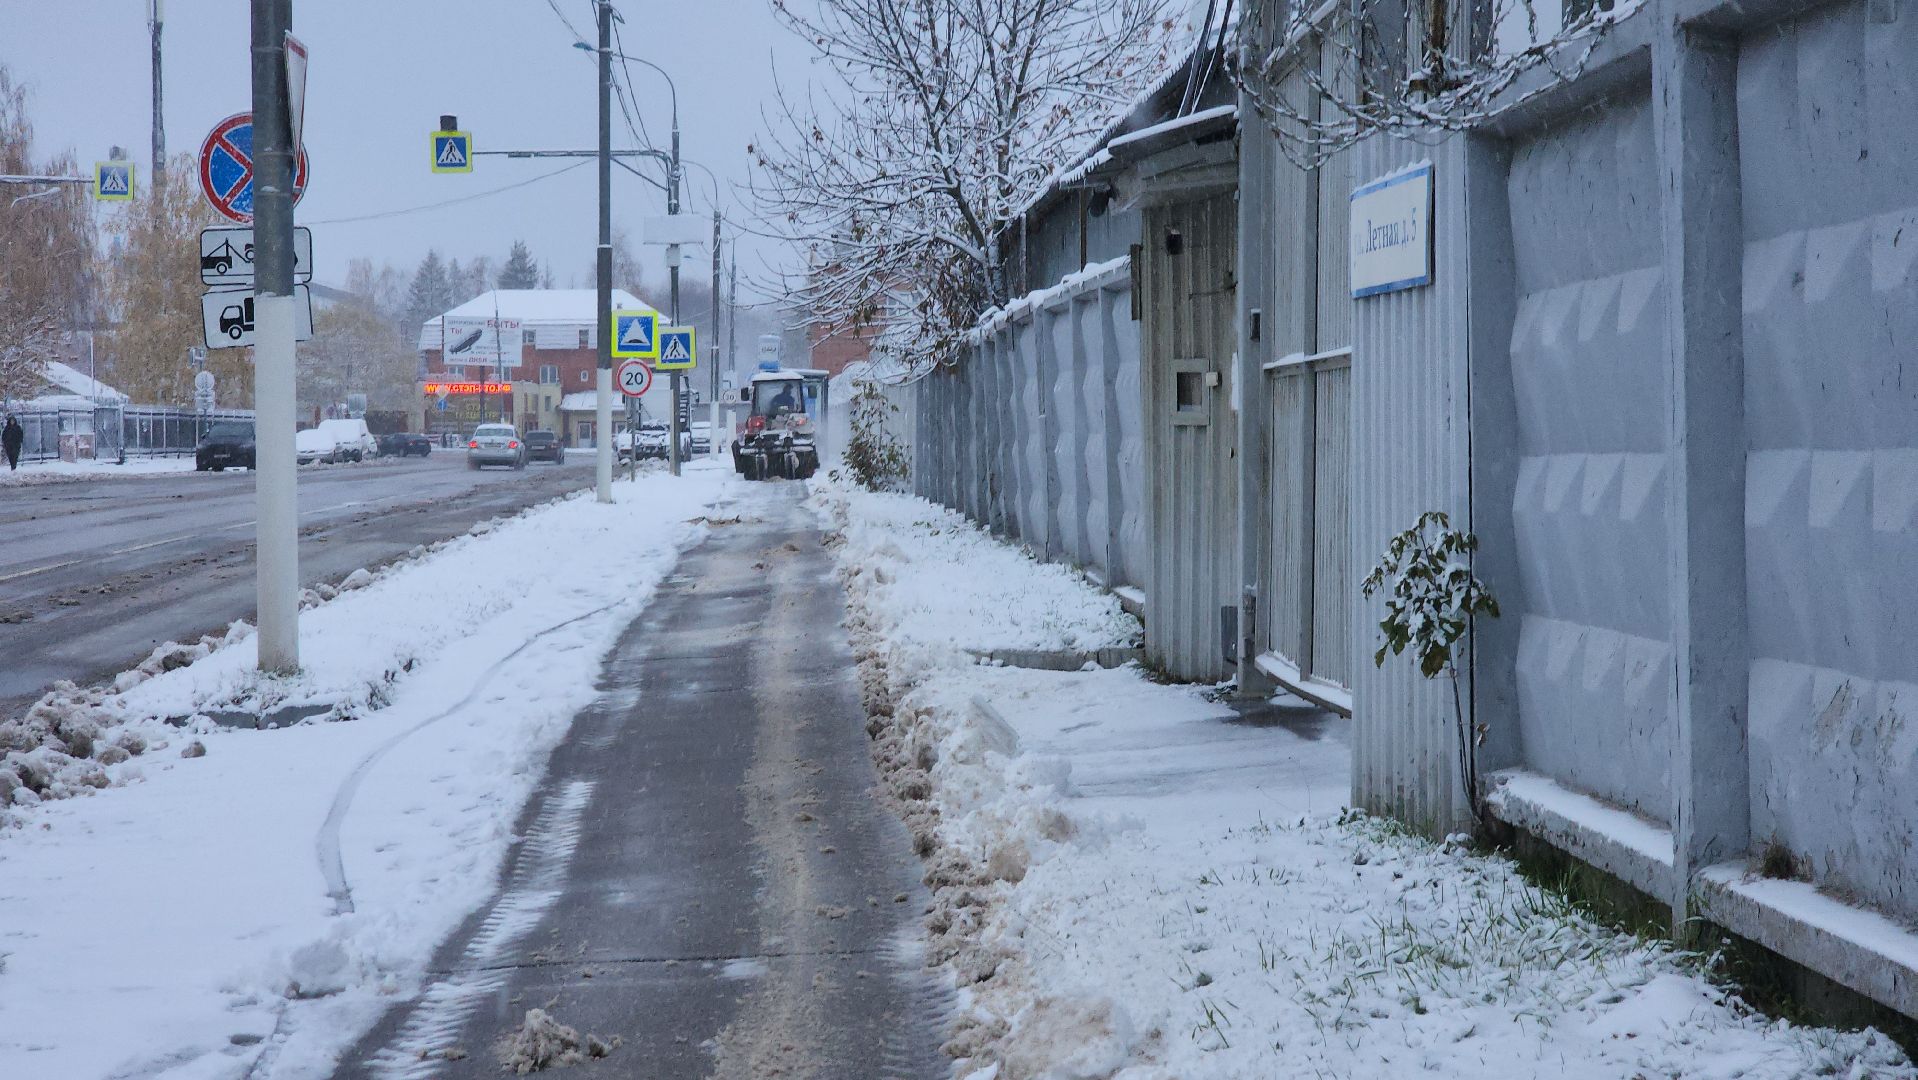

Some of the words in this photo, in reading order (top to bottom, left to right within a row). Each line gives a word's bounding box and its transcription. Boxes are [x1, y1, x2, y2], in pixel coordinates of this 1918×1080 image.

[1366, 219, 1400, 254] Летная
[1411, 206, 1417, 241] 5
[625, 372, 644, 386] 20
